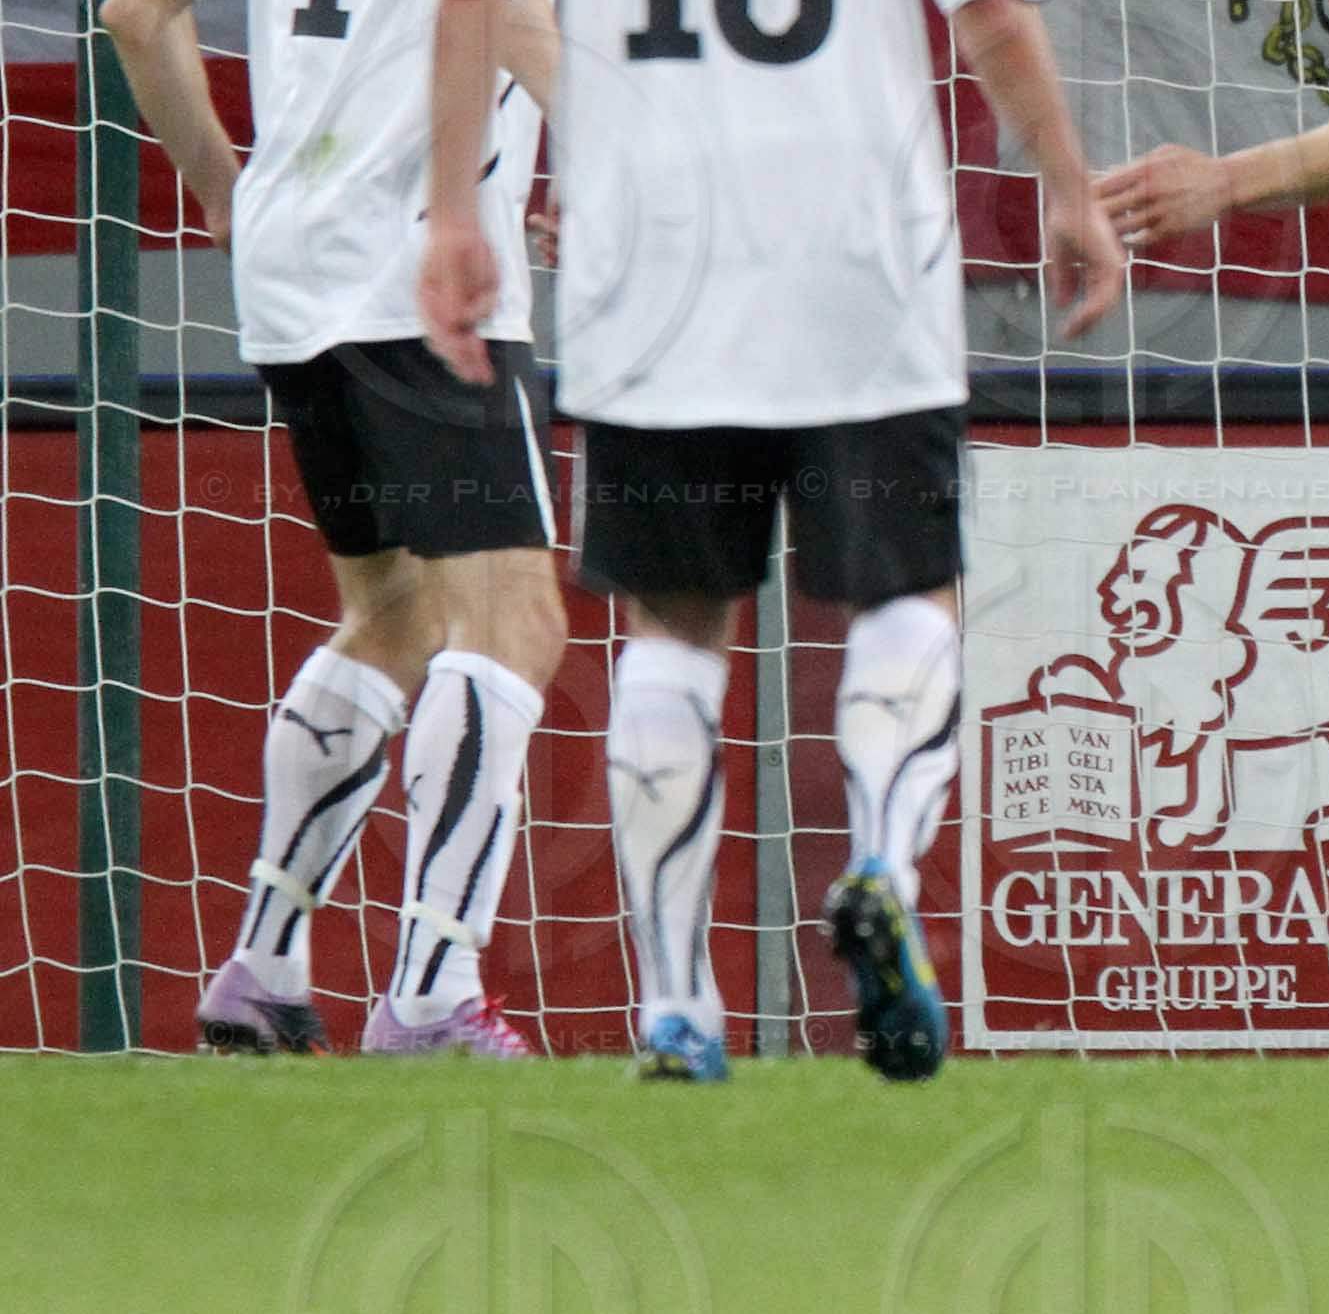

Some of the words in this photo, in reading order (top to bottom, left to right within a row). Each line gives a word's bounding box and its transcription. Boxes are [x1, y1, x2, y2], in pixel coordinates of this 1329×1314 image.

[1004, 729, 1047, 752] PAX
[1069, 727, 1110, 749] VAN
[1004, 753, 1048, 774] TIBI
[1068, 750, 1113, 773] GELI
[1004, 775, 1048, 798] MAR
[1069, 773, 1106, 794] STA
[1004, 802, 1030, 819] CE
[1067, 797, 1120, 819] MEVS
[1098, 965, 1297, 1011] GRUPPE
